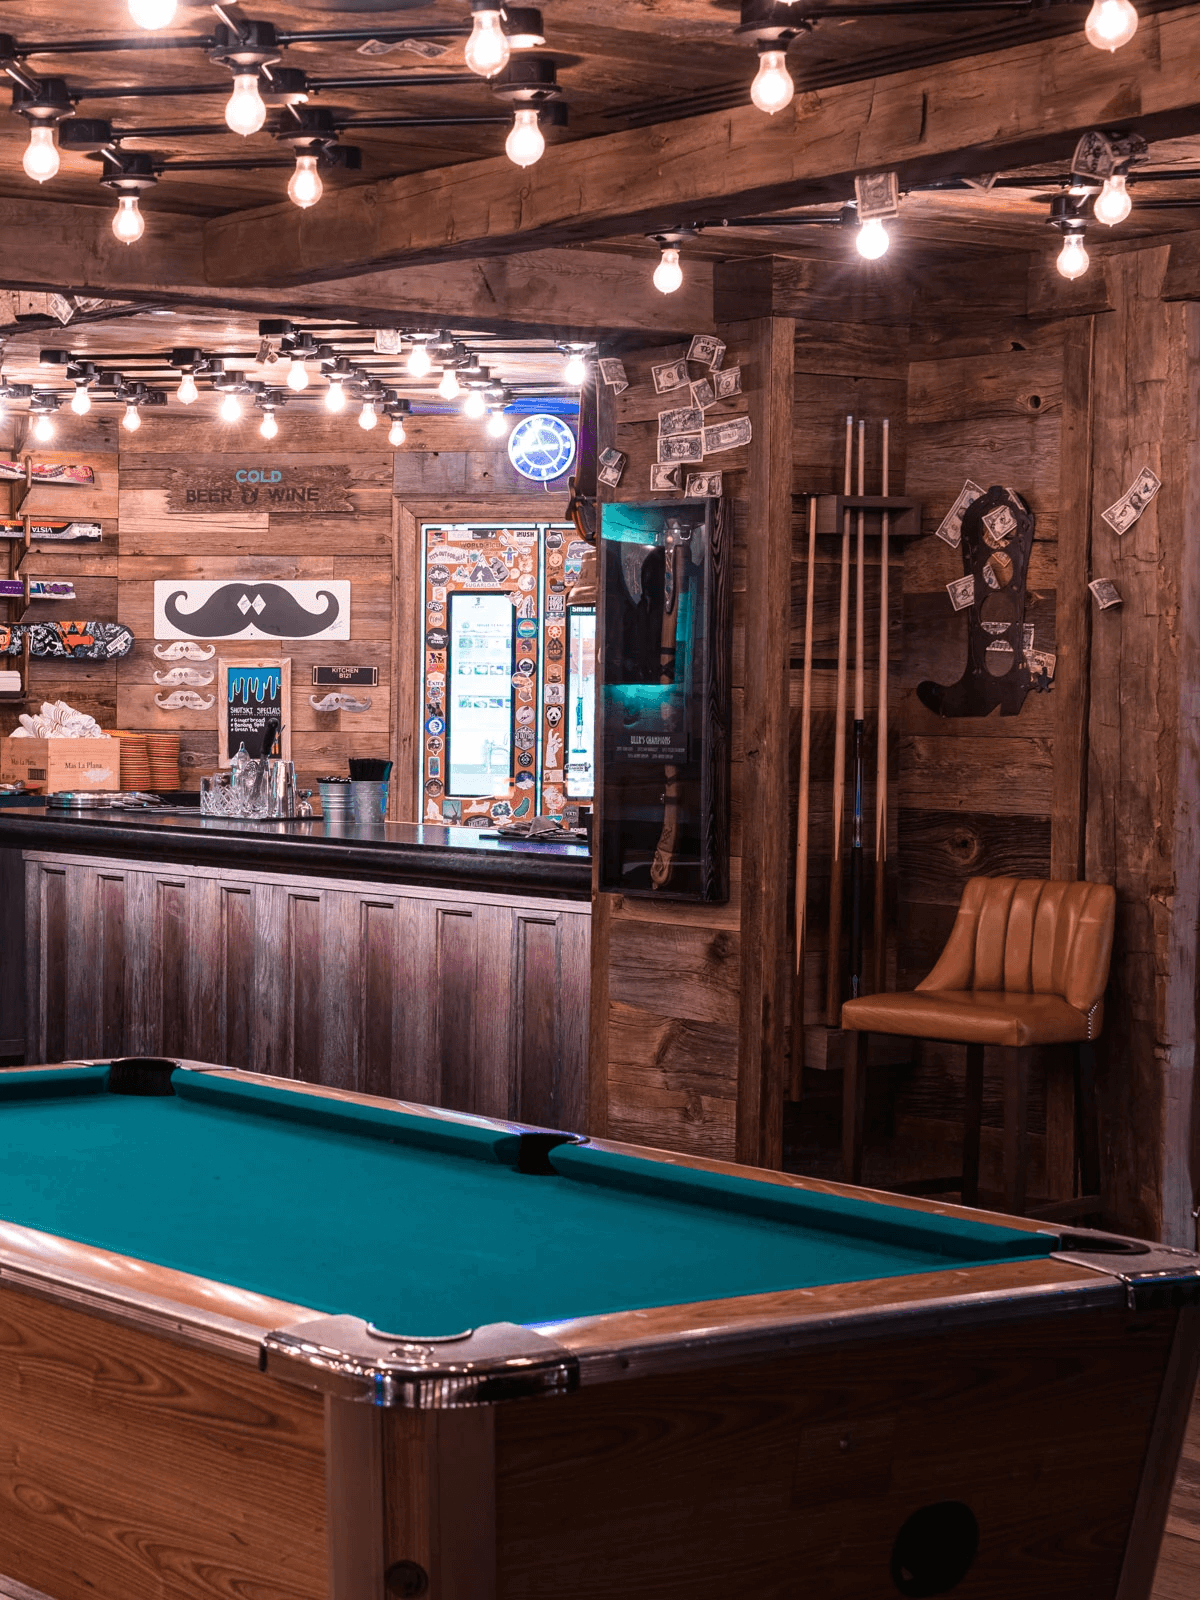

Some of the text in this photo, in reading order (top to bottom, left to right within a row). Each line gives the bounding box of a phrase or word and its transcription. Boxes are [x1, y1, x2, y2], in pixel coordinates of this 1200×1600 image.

[235, 469, 282, 483] COLD
[186, 488, 232, 503] BEER
[268, 487, 320, 502] WINE
[31, 526, 53, 534] VISTA
